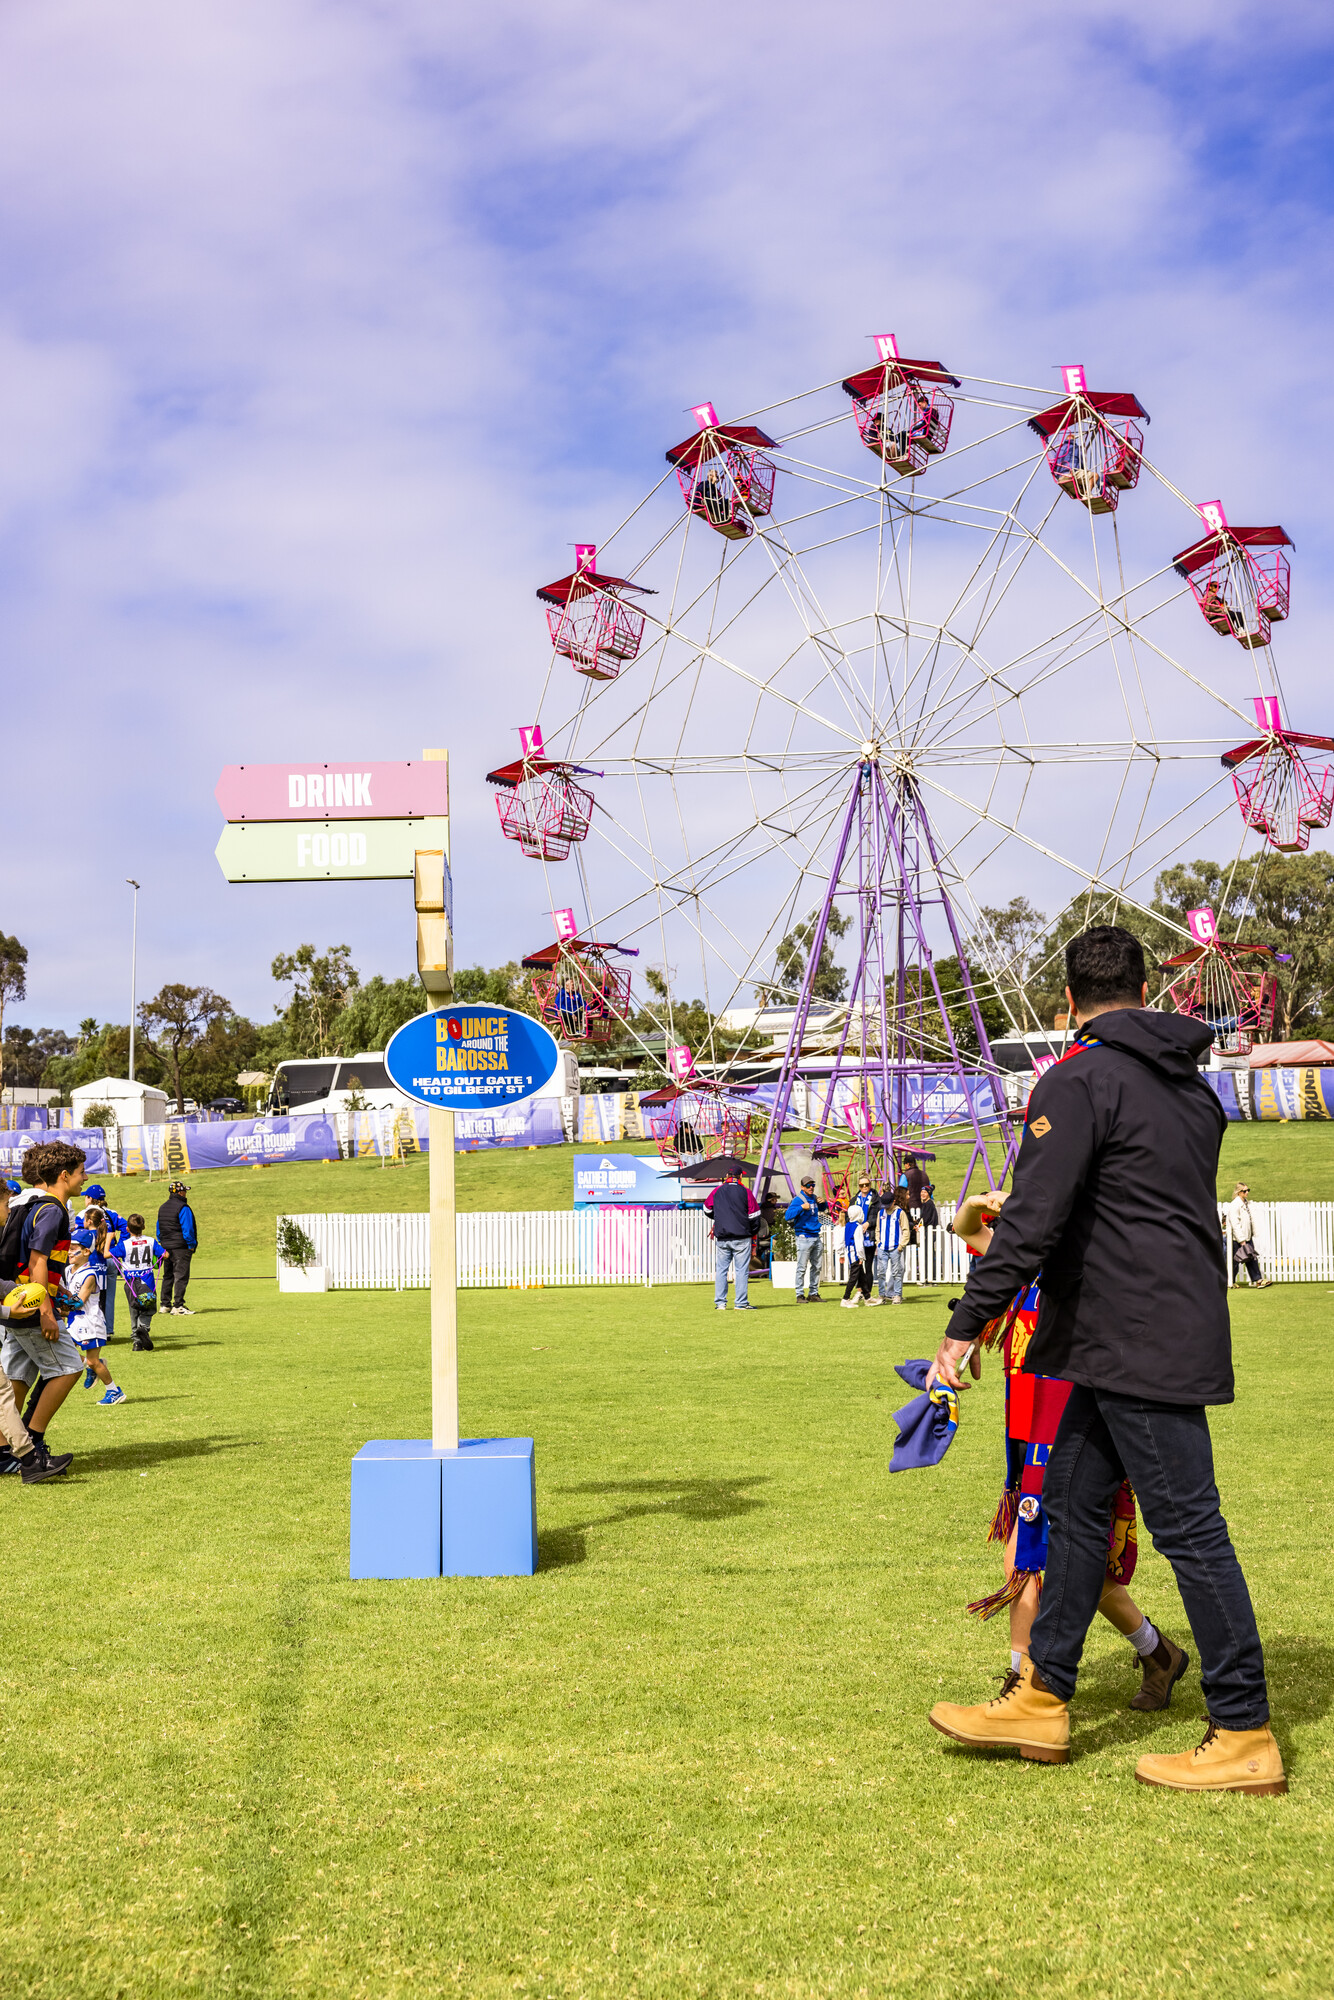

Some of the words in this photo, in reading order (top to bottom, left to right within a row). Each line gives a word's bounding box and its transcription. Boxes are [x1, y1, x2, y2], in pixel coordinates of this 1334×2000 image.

[878, 337, 896, 360] H
[1066, 369, 1083, 394] E
[696, 406, 713, 427] T
[1203, 505, 1223, 530] B
[524, 729, 542, 753] L
[288, 773, 373, 808] DRINK
[297, 832, 367, 868] FOOD
[556, 913, 573, 936] E
[1195, 912, 1214, 939] G
[461, 1037, 493, 1050] AROUND
[495, 1035, 508, 1052] THE
[436, 1047, 508, 1071] BAROSSA
[675, 1050, 690, 1074] E
[413, 1077, 451, 1086] HEAD
[454, 1077, 483, 1085] OUT
[486, 1076, 522, 1085] GATE
[525, 1076, 532, 1084] 1
[421, 1086, 441, 1095] TO
[443, 1085, 503, 1095] GILBERT
[506, 1085, 525, 1094] ST
[1236, 1070, 1252, 1120] GATHER
[1260, 1069, 1281, 1119] ROUND
[1281, 1068, 1297, 1120] GATHER
[1305, 1069, 1326, 1120] ROUND
[458, 1120, 492, 1134] GATHER
[494, 1117, 526, 1132] ROUND
[562, 1096, 574, 1143] GATHER
[623, 1093, 641, 1139] ROUND
[167, 1123, 187, 1170] ROUND
[227, 1135, 262, 1151] GATHER
[264, 1133, 296, 1148] ROUND
[337, 1112, 349, 1159] GATHER
[578, 1171, 607, 1185] GATHER
[608, 1170, 637, 1184] ROUND
[130, 1246, 151, 1265] 44
